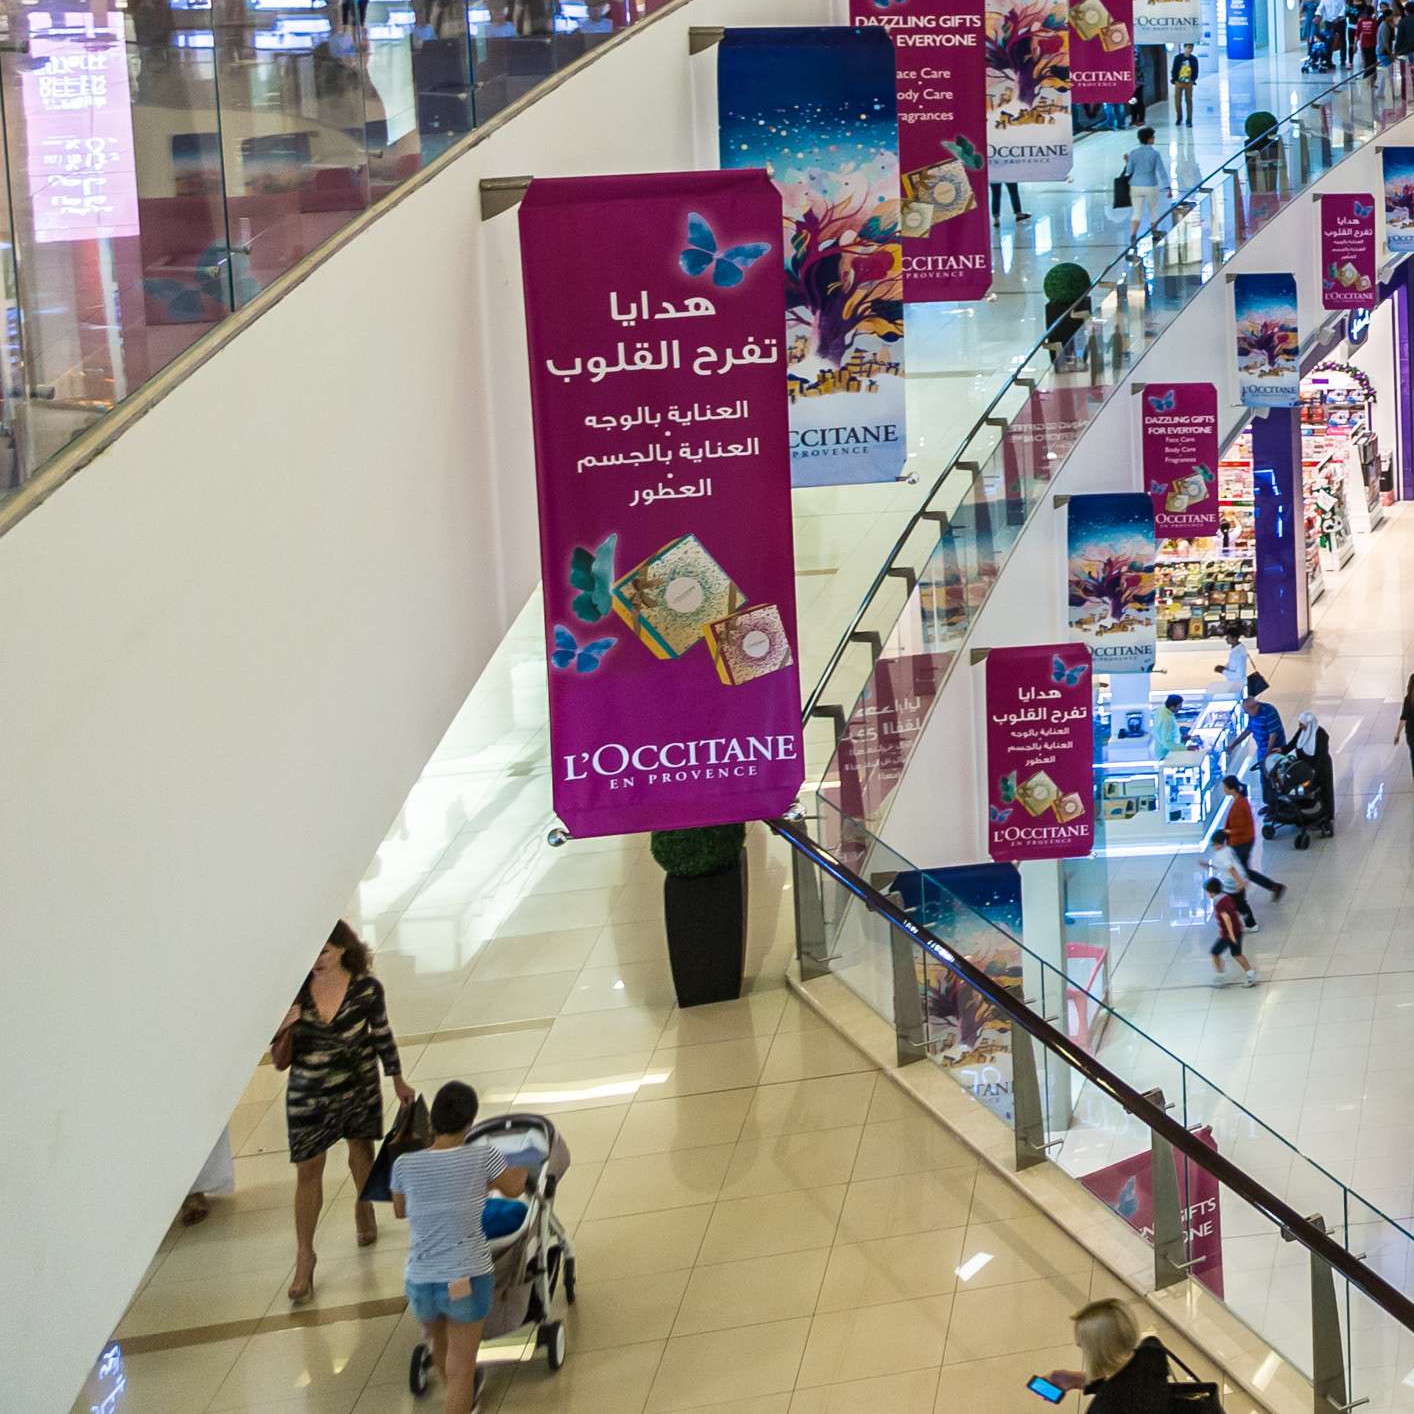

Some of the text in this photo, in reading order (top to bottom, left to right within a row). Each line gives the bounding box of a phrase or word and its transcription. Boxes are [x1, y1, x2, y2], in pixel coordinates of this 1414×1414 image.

[856, 15, 981, 30] DAZZLING GIFTS
[897, 34, 976, 46] EVERYONE
[921, 68, 950, 78] Care
[923, 89, 953, 99] Care
[1325, 292, 1373, 302] L'OCCITANE
[610, 291, 716, 326] هدايا
[546, 337, 777, 382] تفرح القلوب
[1241, 385, 1298, 396] L'OCCITANE
[585, 400, 748, 430] العناية بالوجه
[1145, 416, 1189, 424] DAZZLING
[1168, 426, 1212, 434] EVERYONE
[578, 438, 759, 473] العناية بالجسم
[792, 445, 868, 458] PROVENCE
[630, 478, 711, 506] العطور
[1019, 687, 1061, 702] هدايا
[993, 707, 1086, 725] تفرح القلوب
[564, 736, 796, 782] L'OCCITANE
[610, 764, 757, 789] EN PROVENCE
[994, 825, 1089, 844] L'OCCITANE
